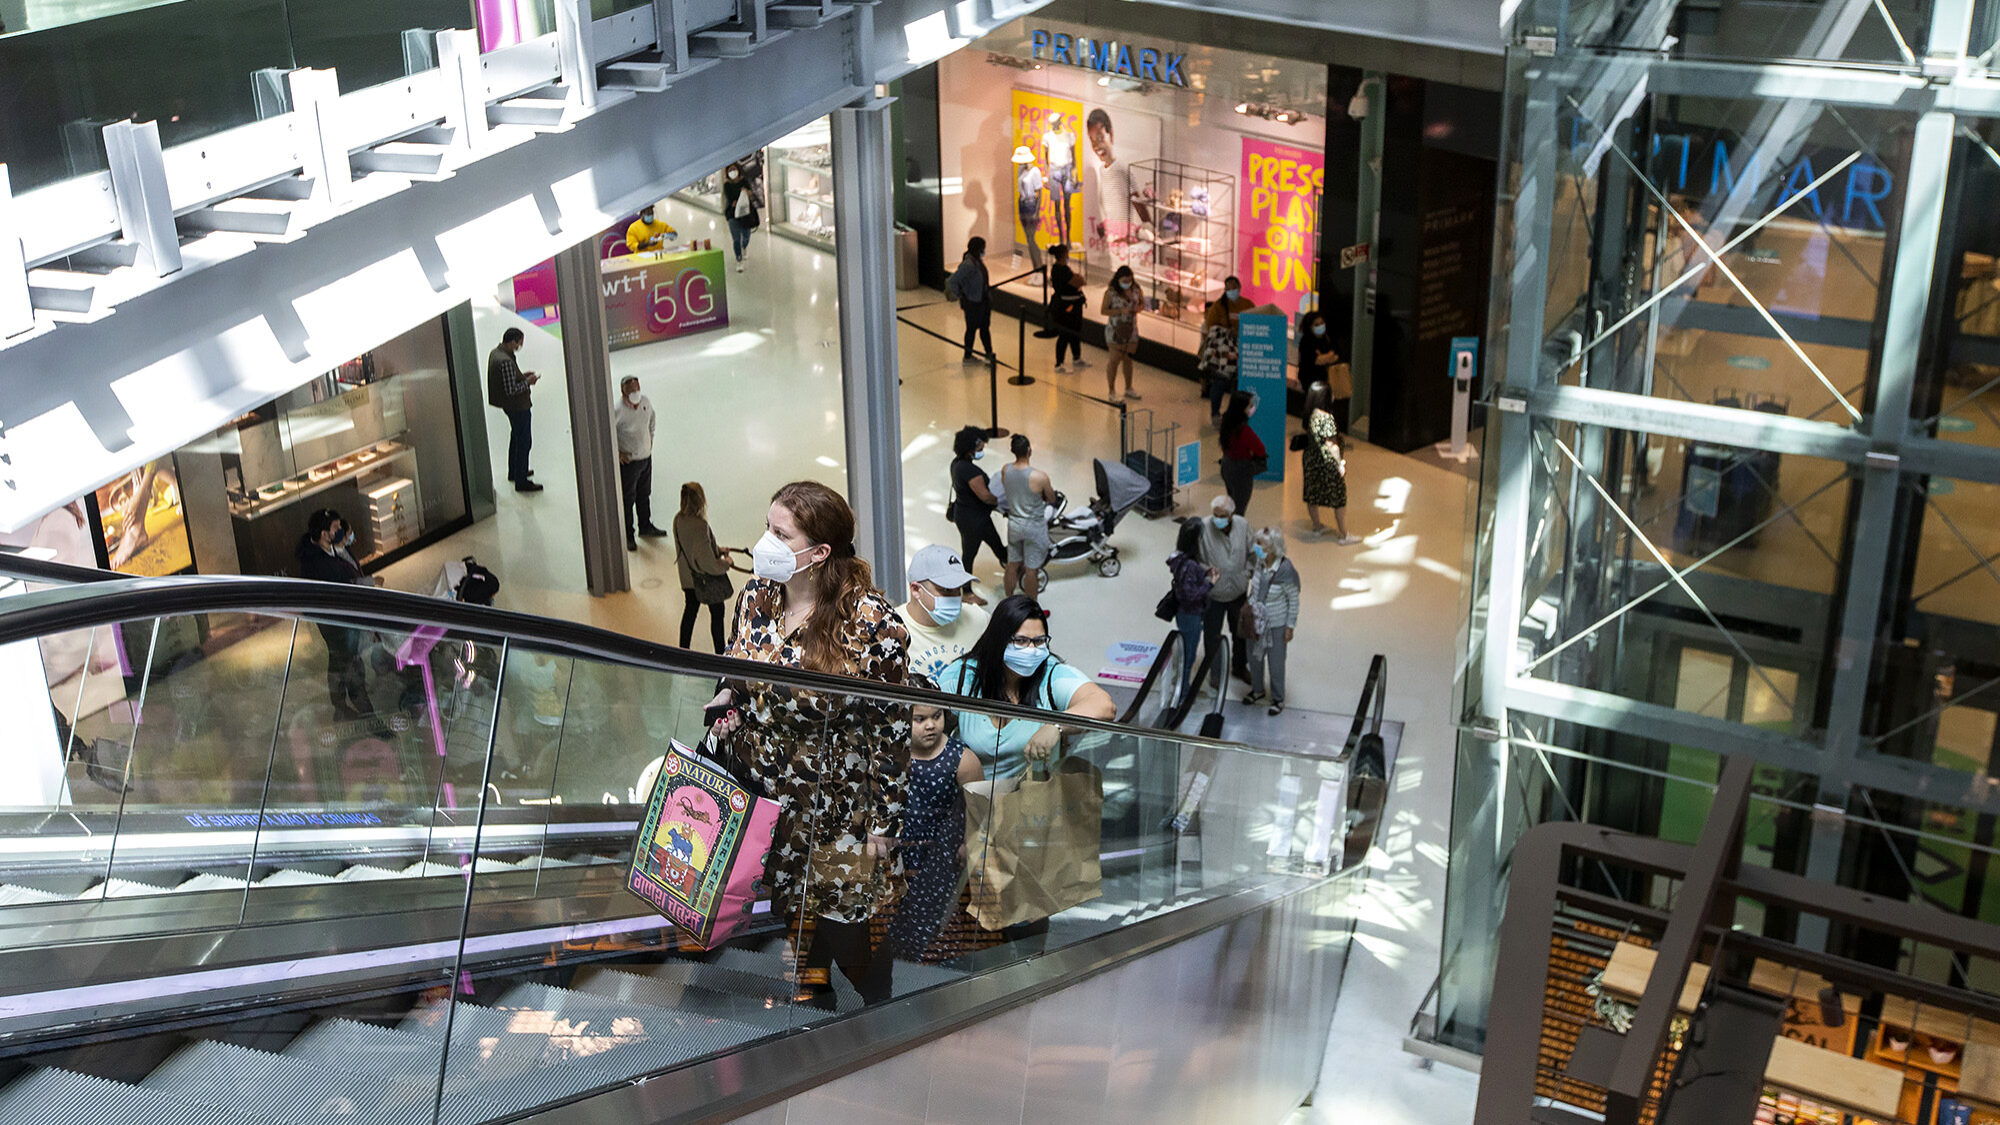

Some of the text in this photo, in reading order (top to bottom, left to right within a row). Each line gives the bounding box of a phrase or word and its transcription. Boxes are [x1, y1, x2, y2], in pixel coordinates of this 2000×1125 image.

[1032, 29, 1185, 88] PRIMARK
[1251, 186, 1319, 233] PLAY
[1266, 225, 1304, 257] ON
[1252, 246, 1317, 292] FUN
[654, 273, 714, 323] 5G
[681, 761, 731, 796] NATURA
[183, 812, 211, 828] DÊ
[207, 814, 266, 827] SEMPRE
[273, 812, 306, 826] MÃO
[321, 812, 382, 826] CRIANÇAS
[641, 774, 667, 846] NAMASTE
[706, 815, 739, 892] MAHATMA
